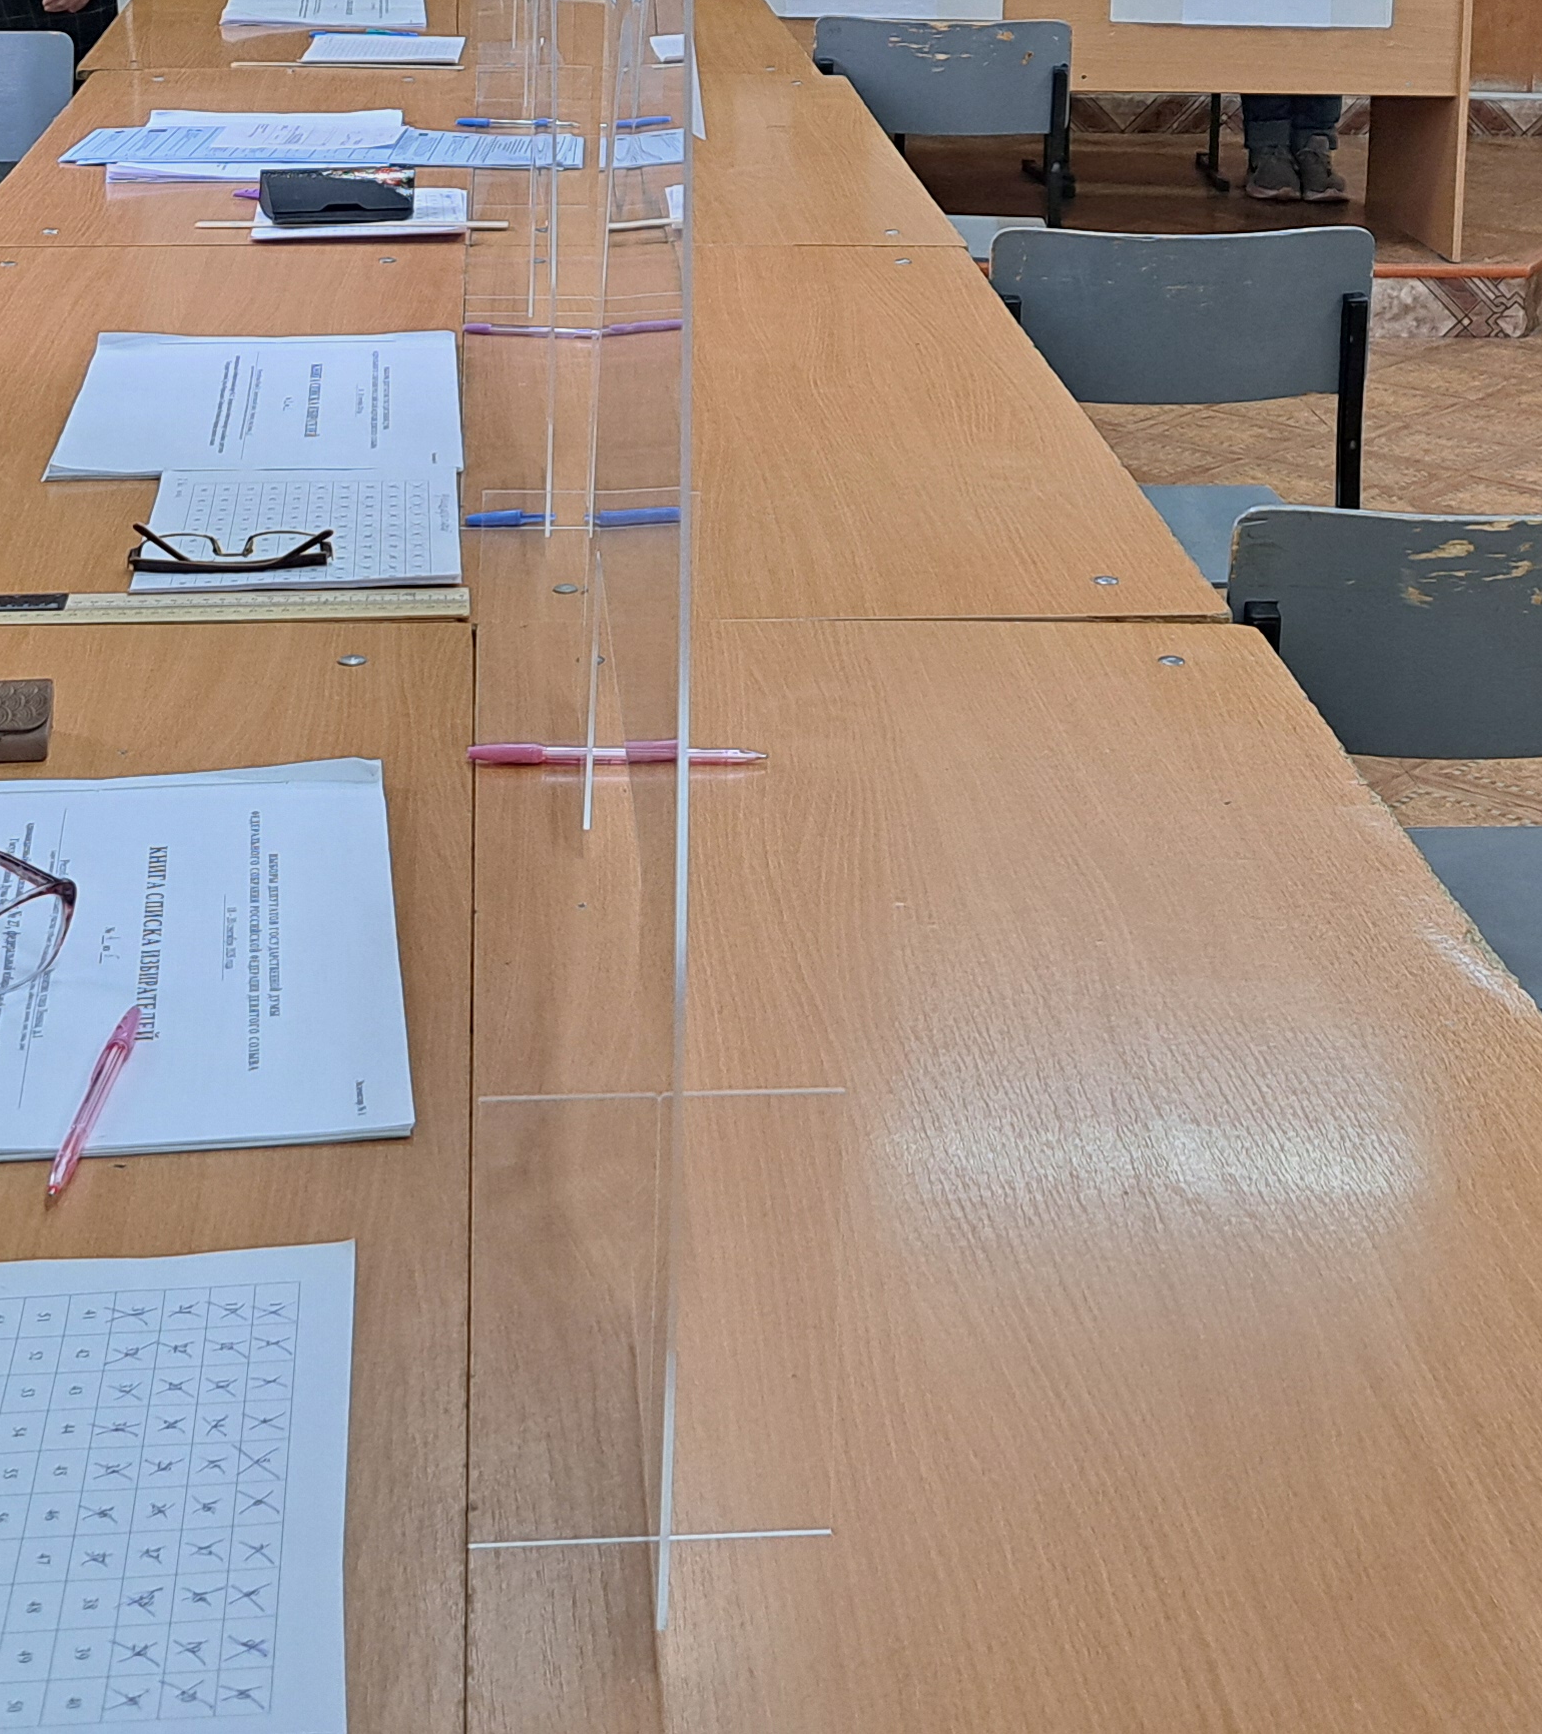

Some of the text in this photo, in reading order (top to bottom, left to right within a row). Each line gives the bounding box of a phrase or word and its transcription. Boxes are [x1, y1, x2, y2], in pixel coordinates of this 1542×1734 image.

[146, 845, 169, 890] КНИГА
[141, 892, 165, 947] СПИСКА
[36, 1312, 52, 1323] 51
[28, 1351, 44, 1361] 52
[20, 1388, 36, 1398] 53
[12, 1427, 28, 1438] 54
[2, 1468, 19, 1480] 55
[6, 1309, 97, 1713] 41 42 43 44 45 46 47 48 49 50
[82, 1597, 100, 1611] 38
[74, 1647, 92, 1661] 39
[65, 1697, 82, 1710] 40
